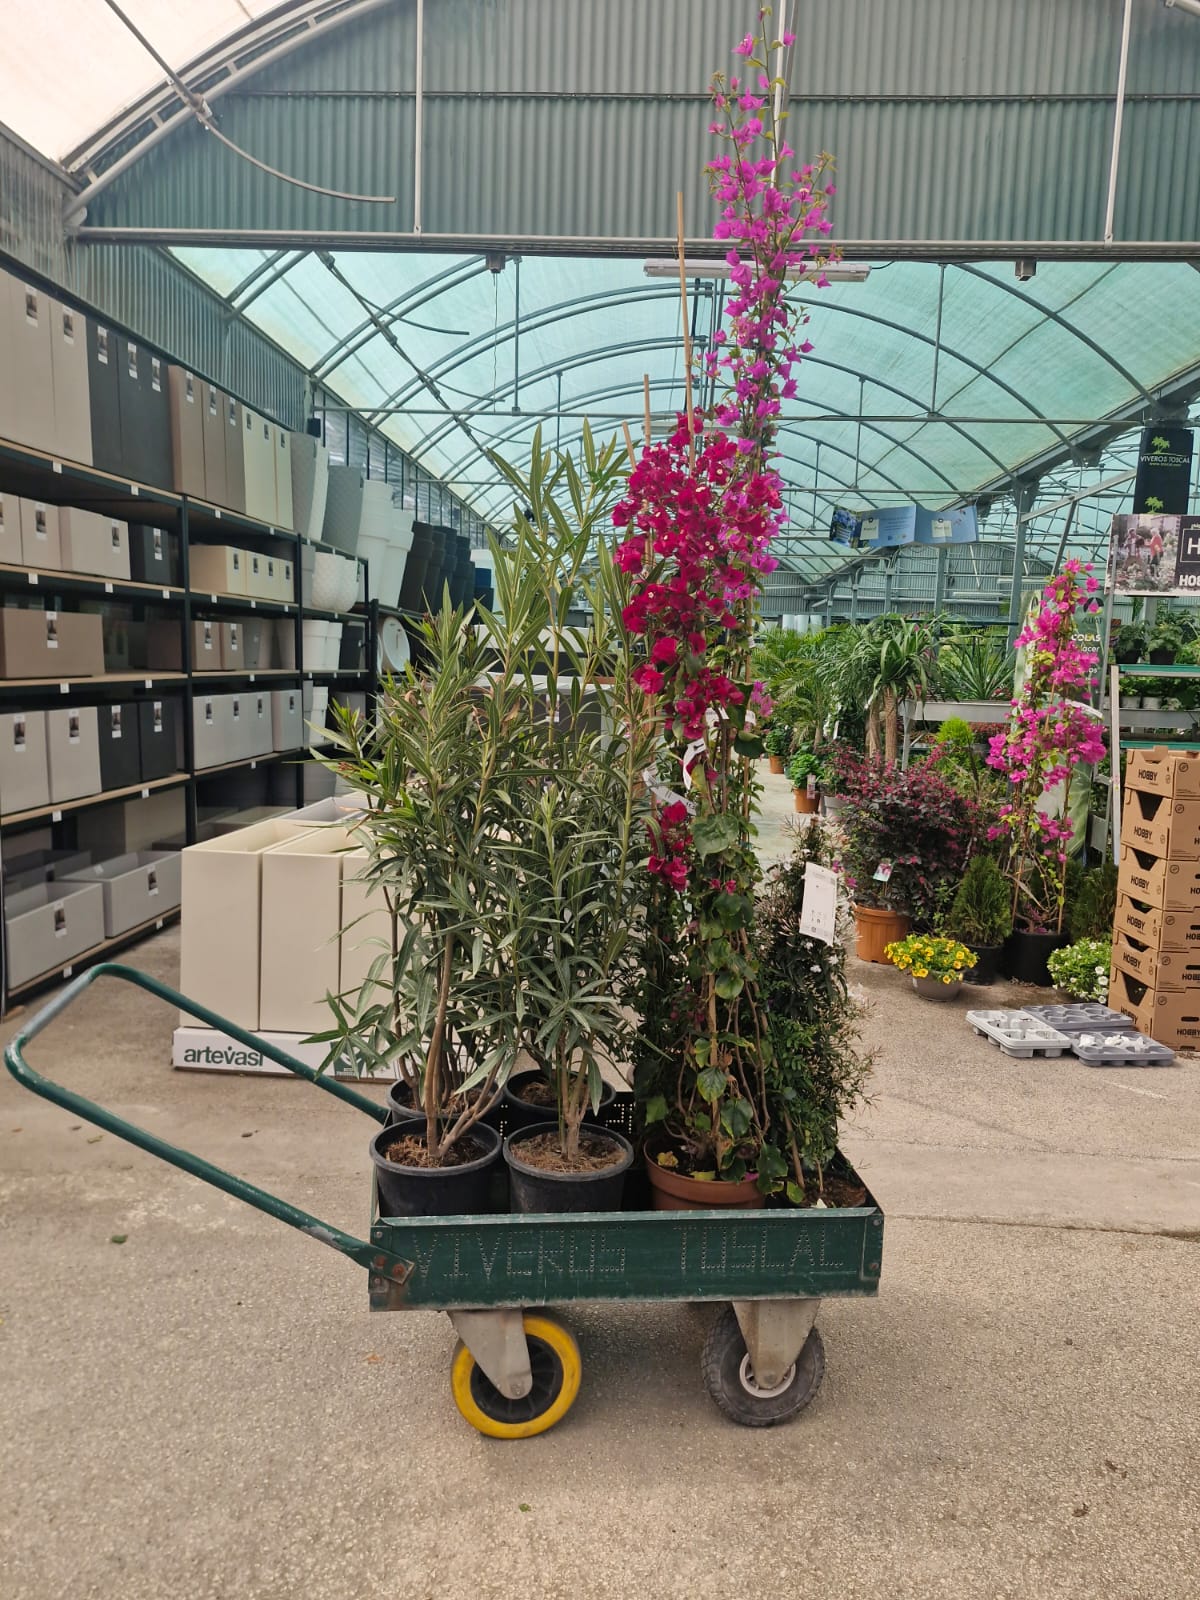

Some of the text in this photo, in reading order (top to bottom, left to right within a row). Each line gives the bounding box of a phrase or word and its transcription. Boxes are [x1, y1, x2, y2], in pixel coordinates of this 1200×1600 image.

[1138, 768, 1158, 781] HOBBY
[1134, 826, 1153, 840] HOBBY
[1130, 875, 1150, 890] HOBBY
[1127, 914, 1146, 930] HOBBY
[1123, 952, 1142, 969] HOBBY
[183, 1046, 264, 1067] artevasi
[412, 1223, 844, 1281] VIVEROS TOSCAL
